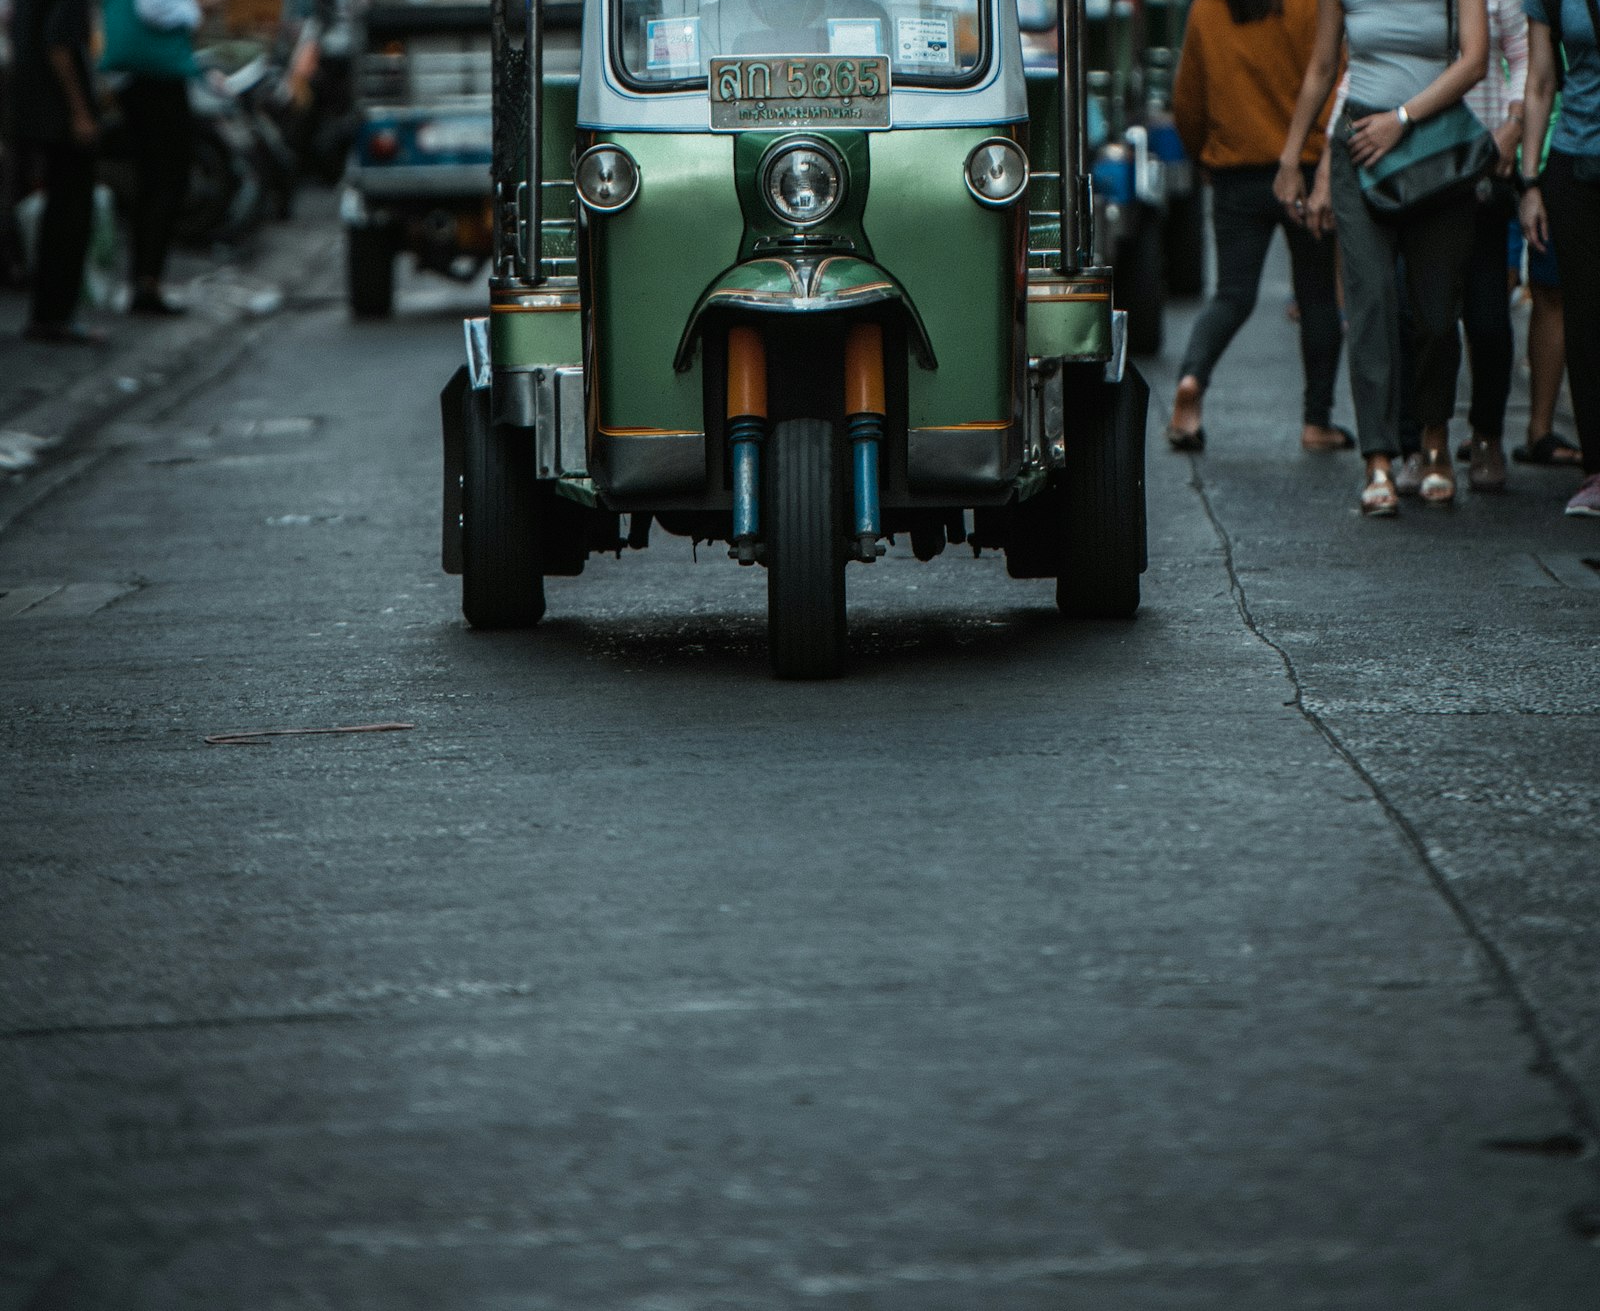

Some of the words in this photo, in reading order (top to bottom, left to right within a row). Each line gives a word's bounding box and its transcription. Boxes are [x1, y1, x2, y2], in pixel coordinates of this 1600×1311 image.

[787, 60, 880, 99] 5865
[739, 106, 862, 122] กรุงเทพมหานคร
